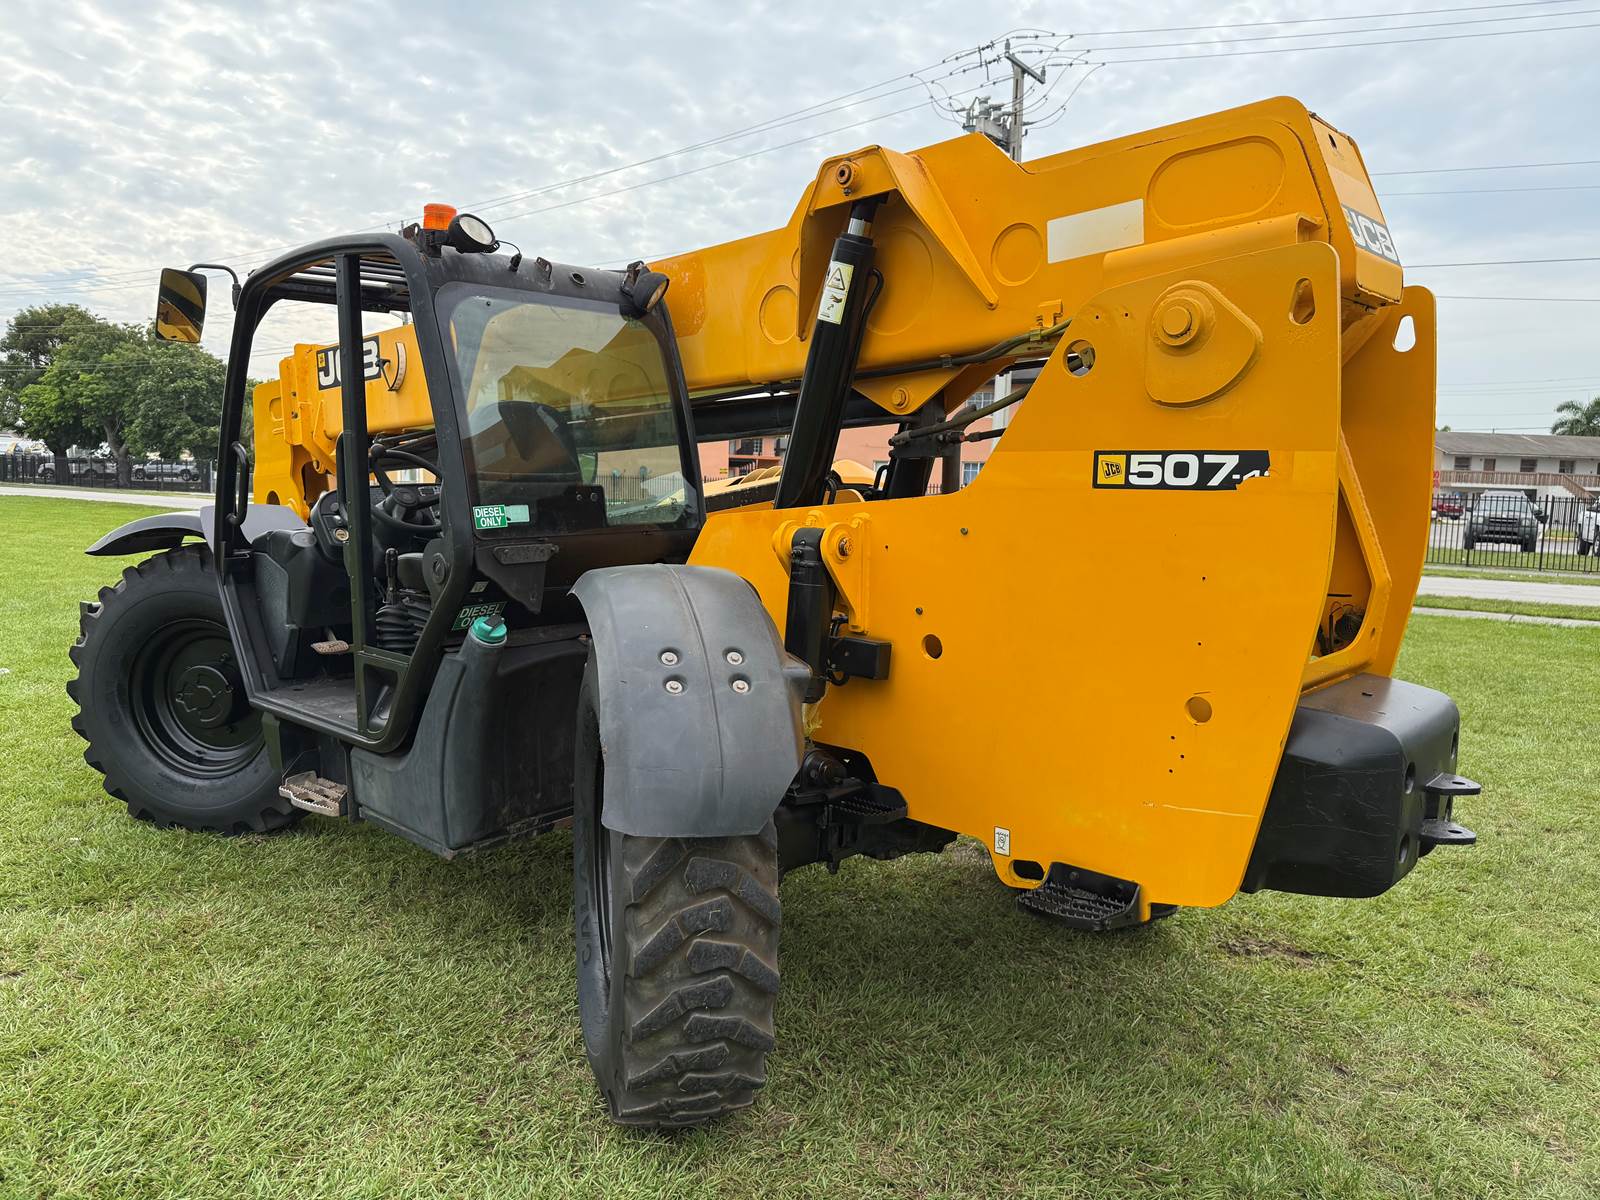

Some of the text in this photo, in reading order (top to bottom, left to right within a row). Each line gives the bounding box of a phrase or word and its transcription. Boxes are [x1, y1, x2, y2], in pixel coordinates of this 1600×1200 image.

[1349, 210, 1398, 262] JCB
[319, 341, 380, 386] JB
[1104, 460, 1121, 477] JCB
[474, 506, 505, 518] DIESEL
[480, 517, 502, 527] ONLY
[460, 603, 501, 618] DIESEL
